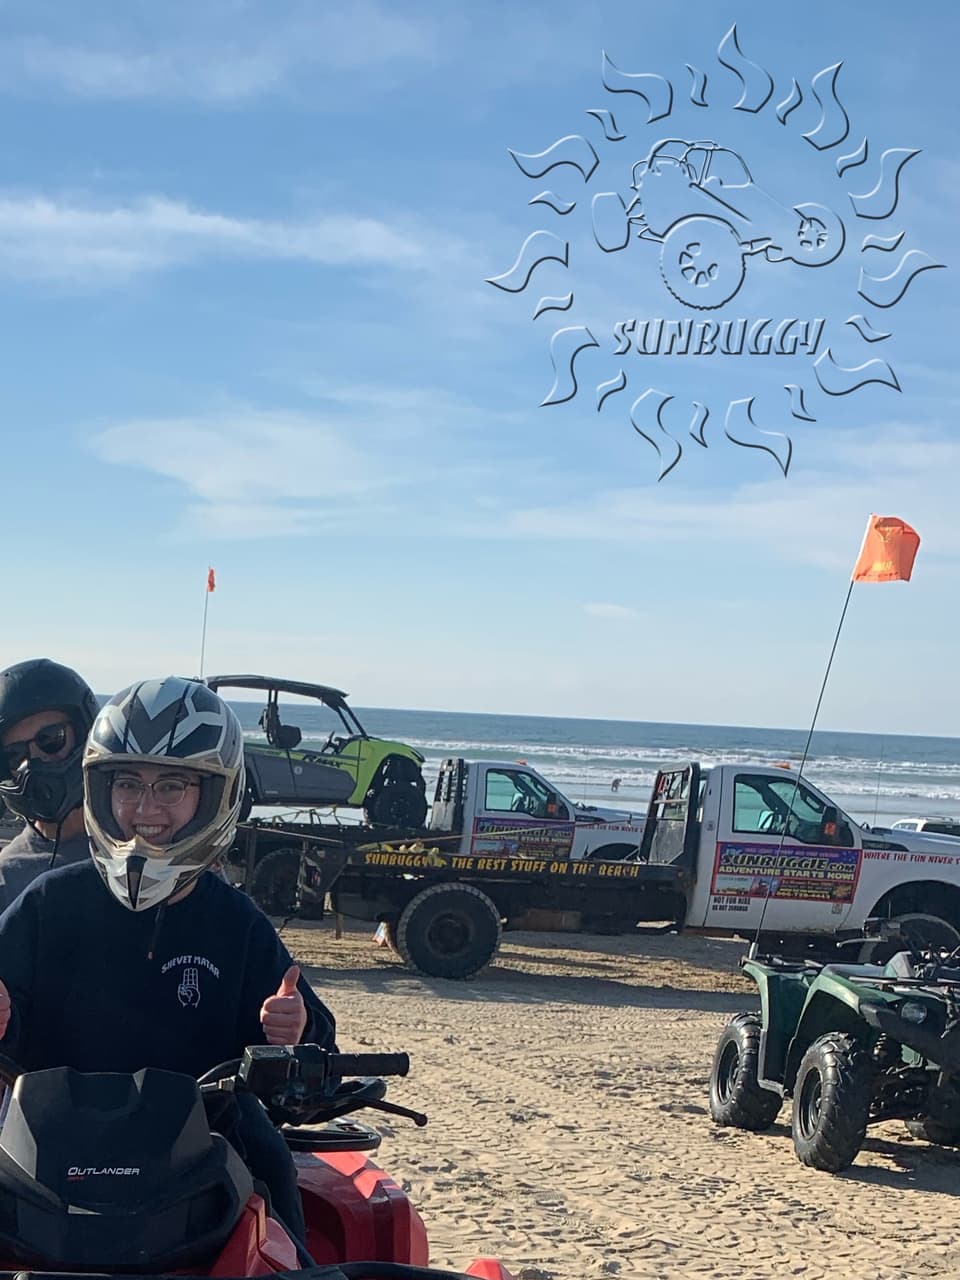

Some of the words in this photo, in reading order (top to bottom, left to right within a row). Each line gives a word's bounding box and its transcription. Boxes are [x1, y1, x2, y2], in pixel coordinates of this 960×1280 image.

[894, 853, 907, 861] THE
[451, 857, 473, 869] THE
[477, 857, 507, 870] BEST
[510, 860, 546, 872] STUFF
[550, 862, 568, 874] ON
[719, 866, 781, 876] ADVENTURE
[161, 955, 193, 974] SHEVET
[68, 1167, 140, 1176] OUTLANDER
